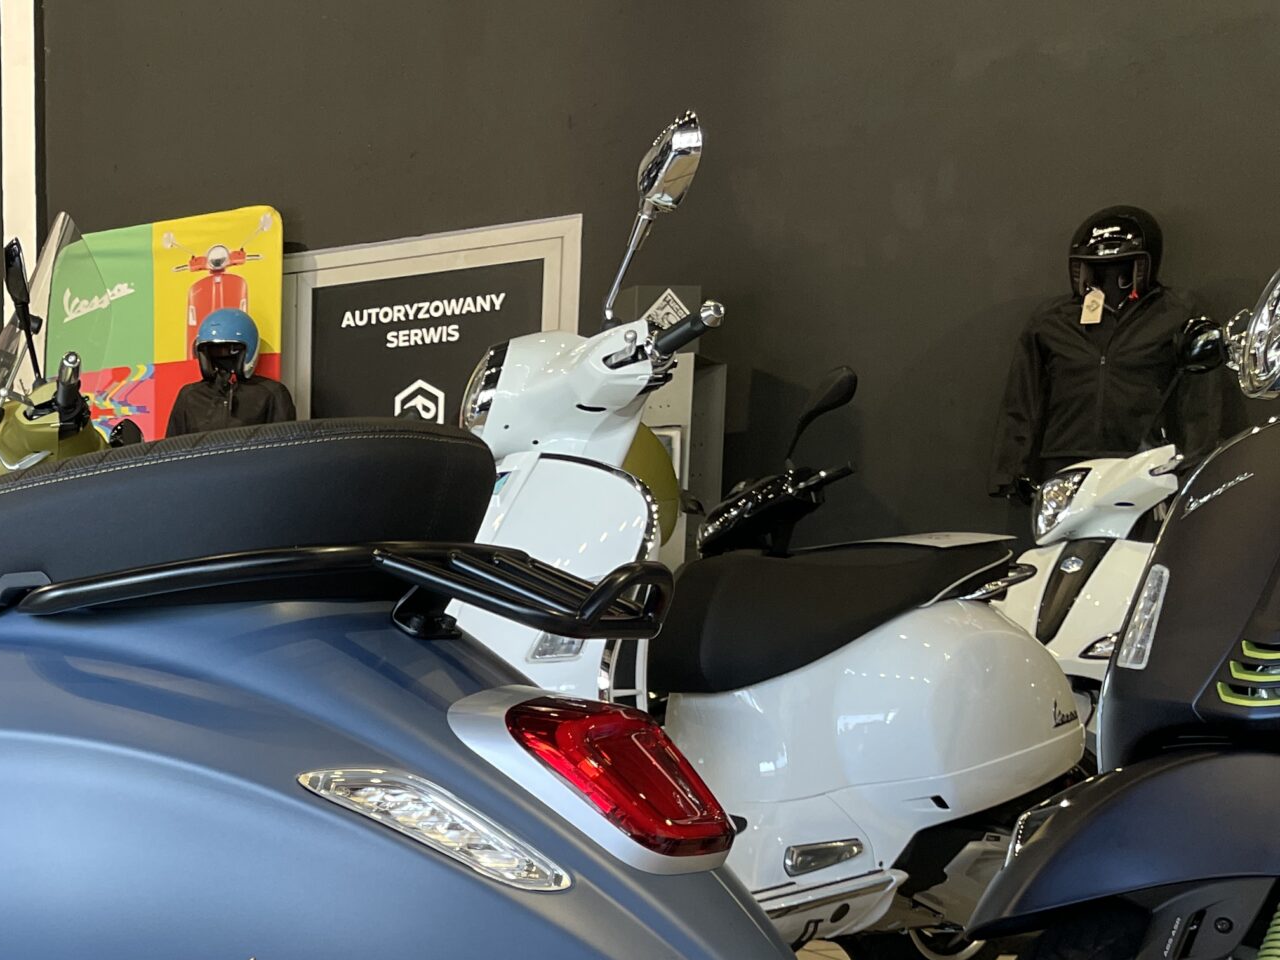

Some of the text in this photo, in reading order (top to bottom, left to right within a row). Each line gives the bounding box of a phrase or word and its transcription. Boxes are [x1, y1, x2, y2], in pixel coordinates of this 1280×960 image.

[63, 283, 135, 323] Vespa
[341, 293, 505, 328] AUTORYZOWANY
[386, 325, 460, 348] SERWIS
